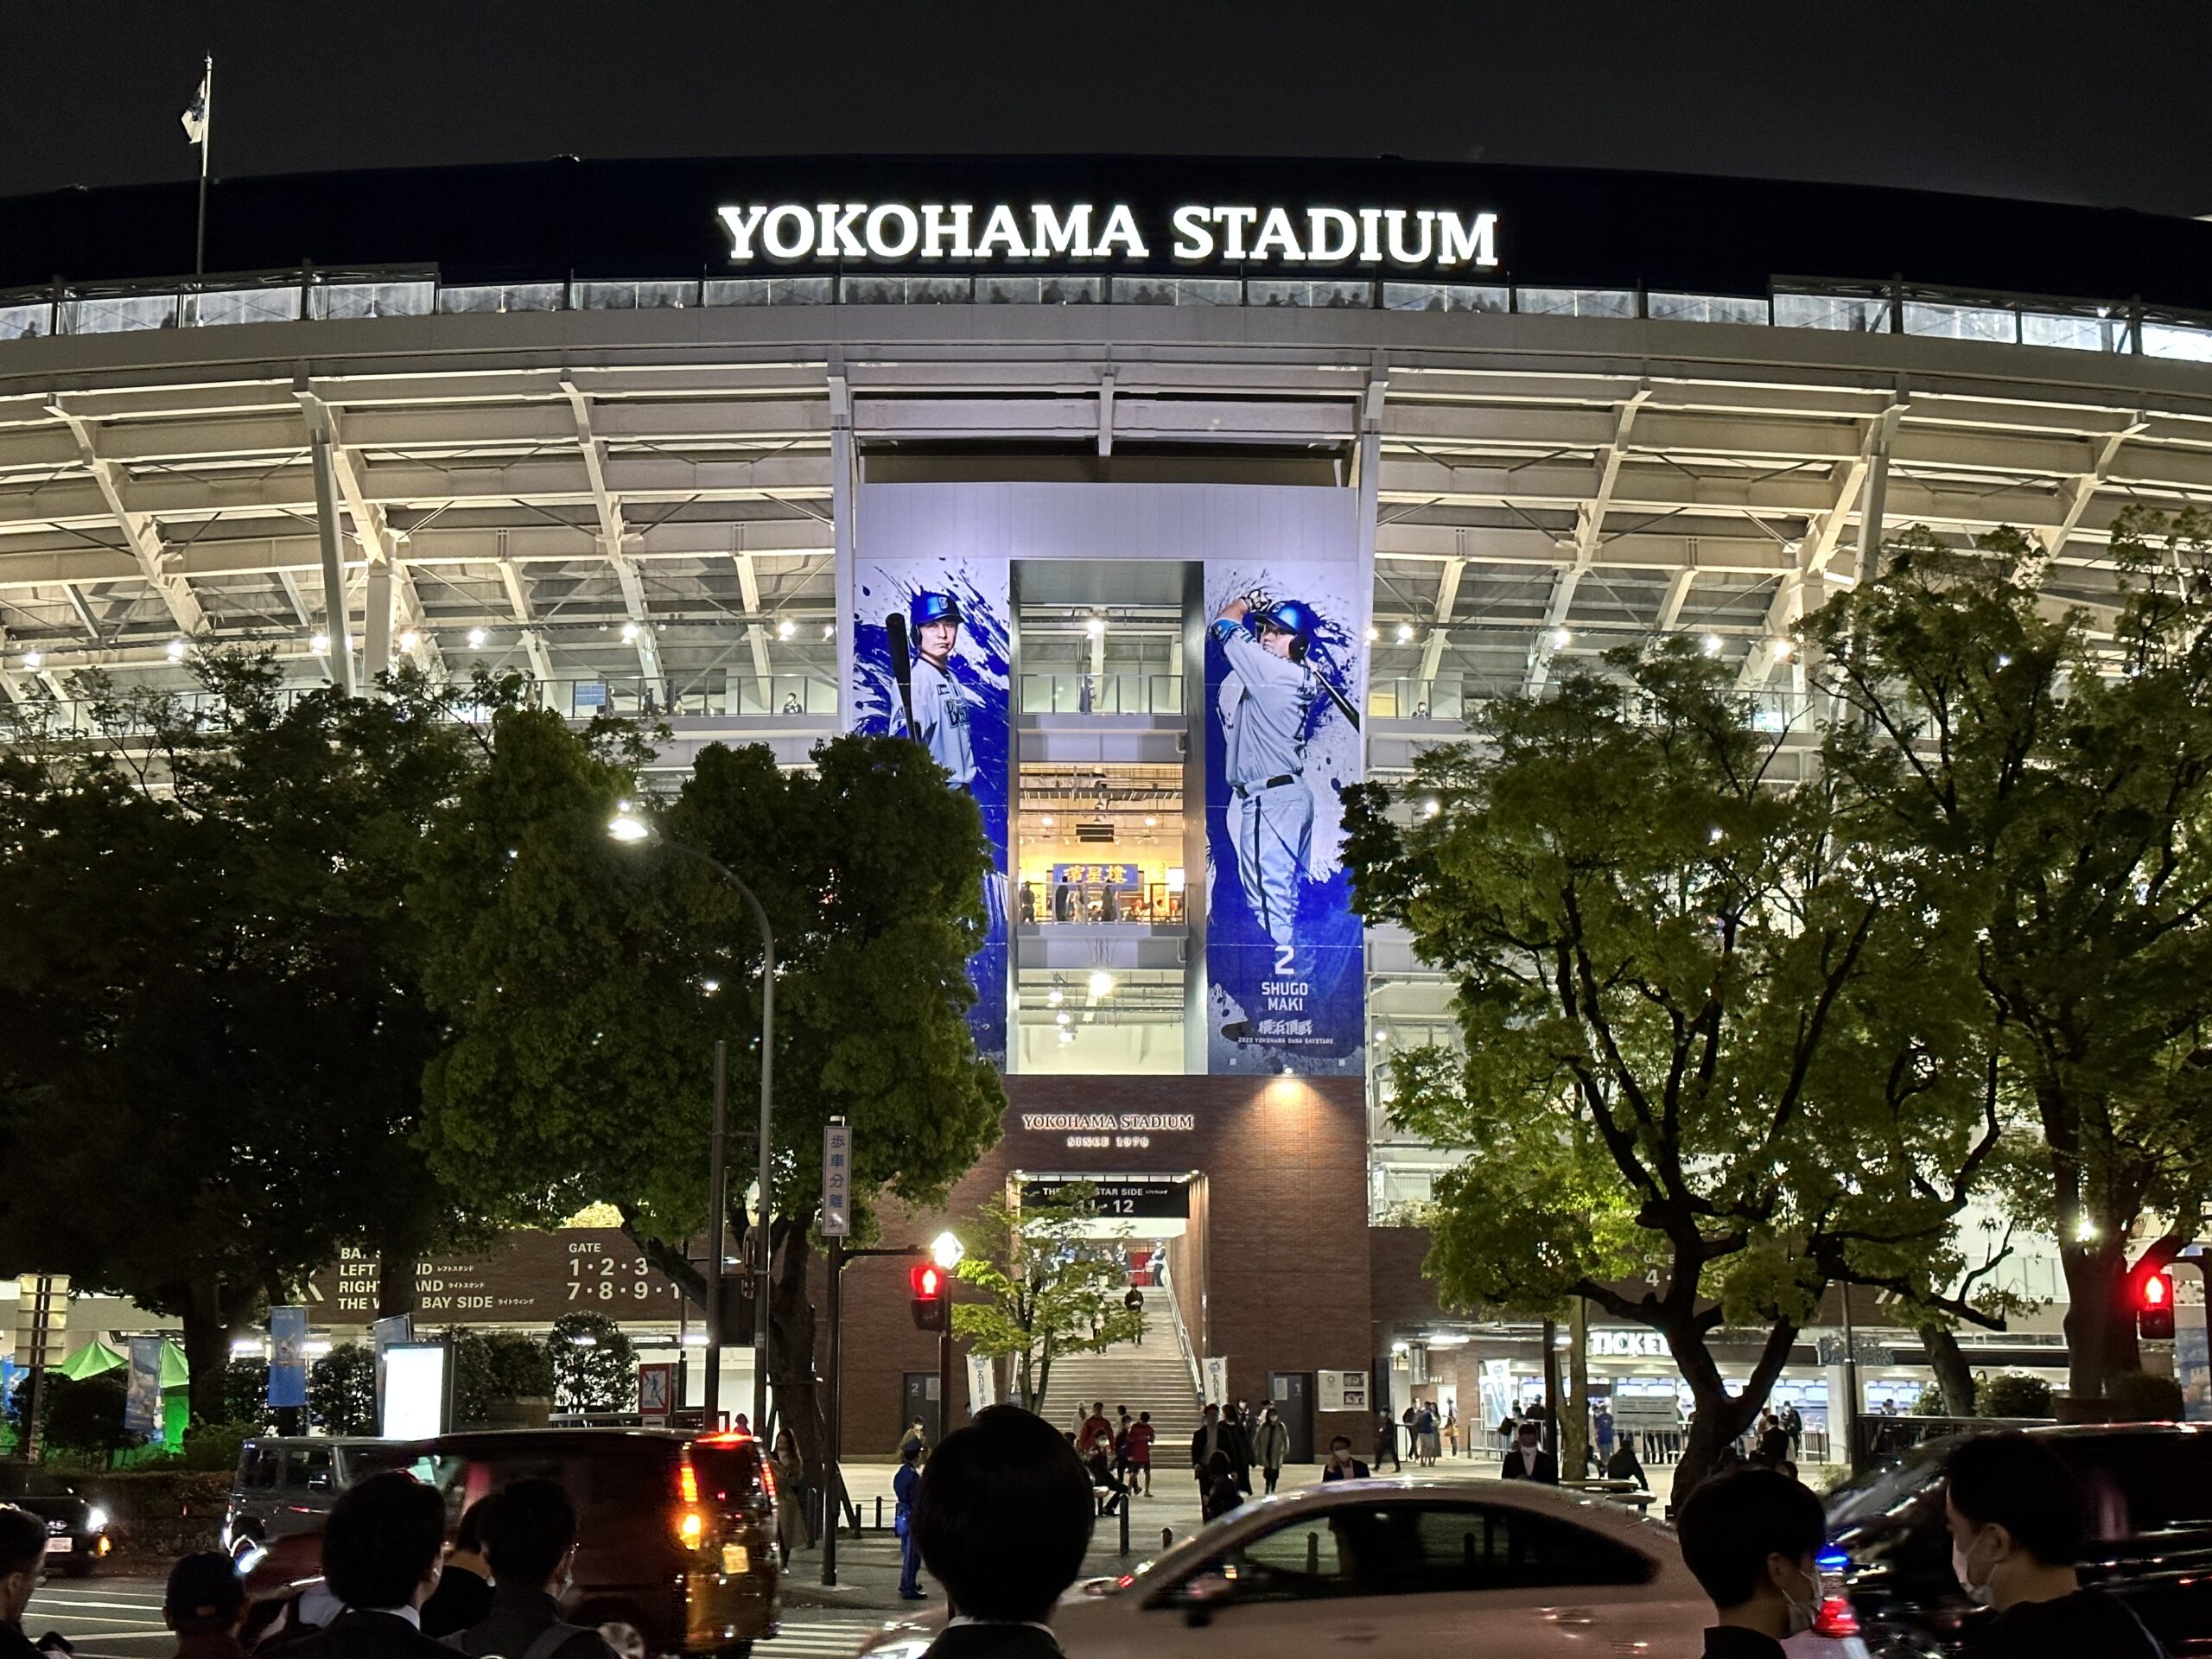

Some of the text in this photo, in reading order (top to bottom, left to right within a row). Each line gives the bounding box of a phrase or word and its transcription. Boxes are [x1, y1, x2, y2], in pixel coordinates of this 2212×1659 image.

[718, 204, 1498, 267] YOKOHAMA STADIUM
[1274, 945, 1294, 975] 2
[1262, 982, 1308, 995] SHUGO
[1268, 998, 1303, 1011] MAKI
[1022, 1114, 1194, 1130] YOKOHAMA STADIUM
[1067, 1136, 1109, 1147] SINCE
[1121, 1187, 1143, 1196] SIDE
[569, 1243, 601, 1253] GATE
[340, 1264, 376, 1276] LEFT
[436, 1264, 474, 1273] レフトスタンド
[338, 1298, 367, 1310] THE
[422, 1296, 493, 1309] BAY SIDE
[1819, 1338, 1894, 1366] BASTARS
[911, 1383, 918, 1393] 2
